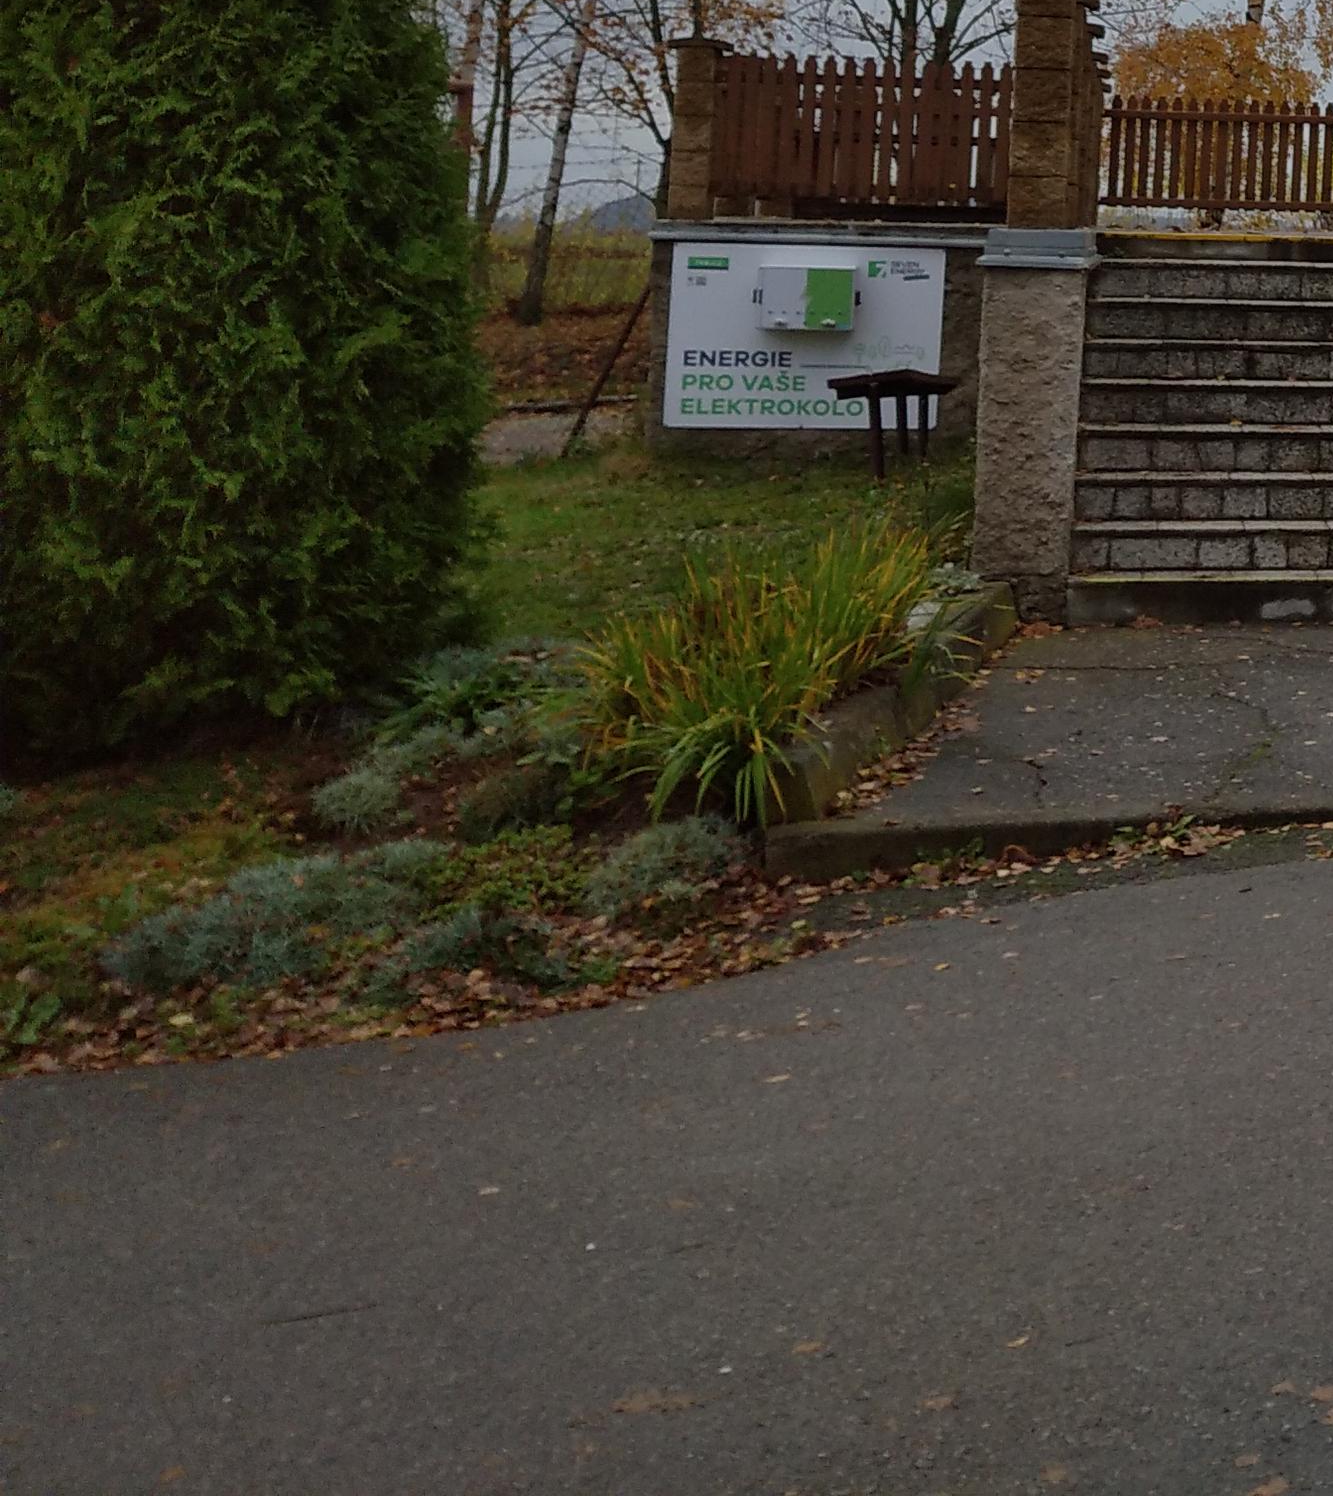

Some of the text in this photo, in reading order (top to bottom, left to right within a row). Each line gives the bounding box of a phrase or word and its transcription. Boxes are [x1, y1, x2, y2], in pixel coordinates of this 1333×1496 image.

[683, 350, 793, 368] ENERGIE
[681, 370, 807, 392] PRO VAŠE
[680, 398, 864, 417] ELEKTROKOLO
